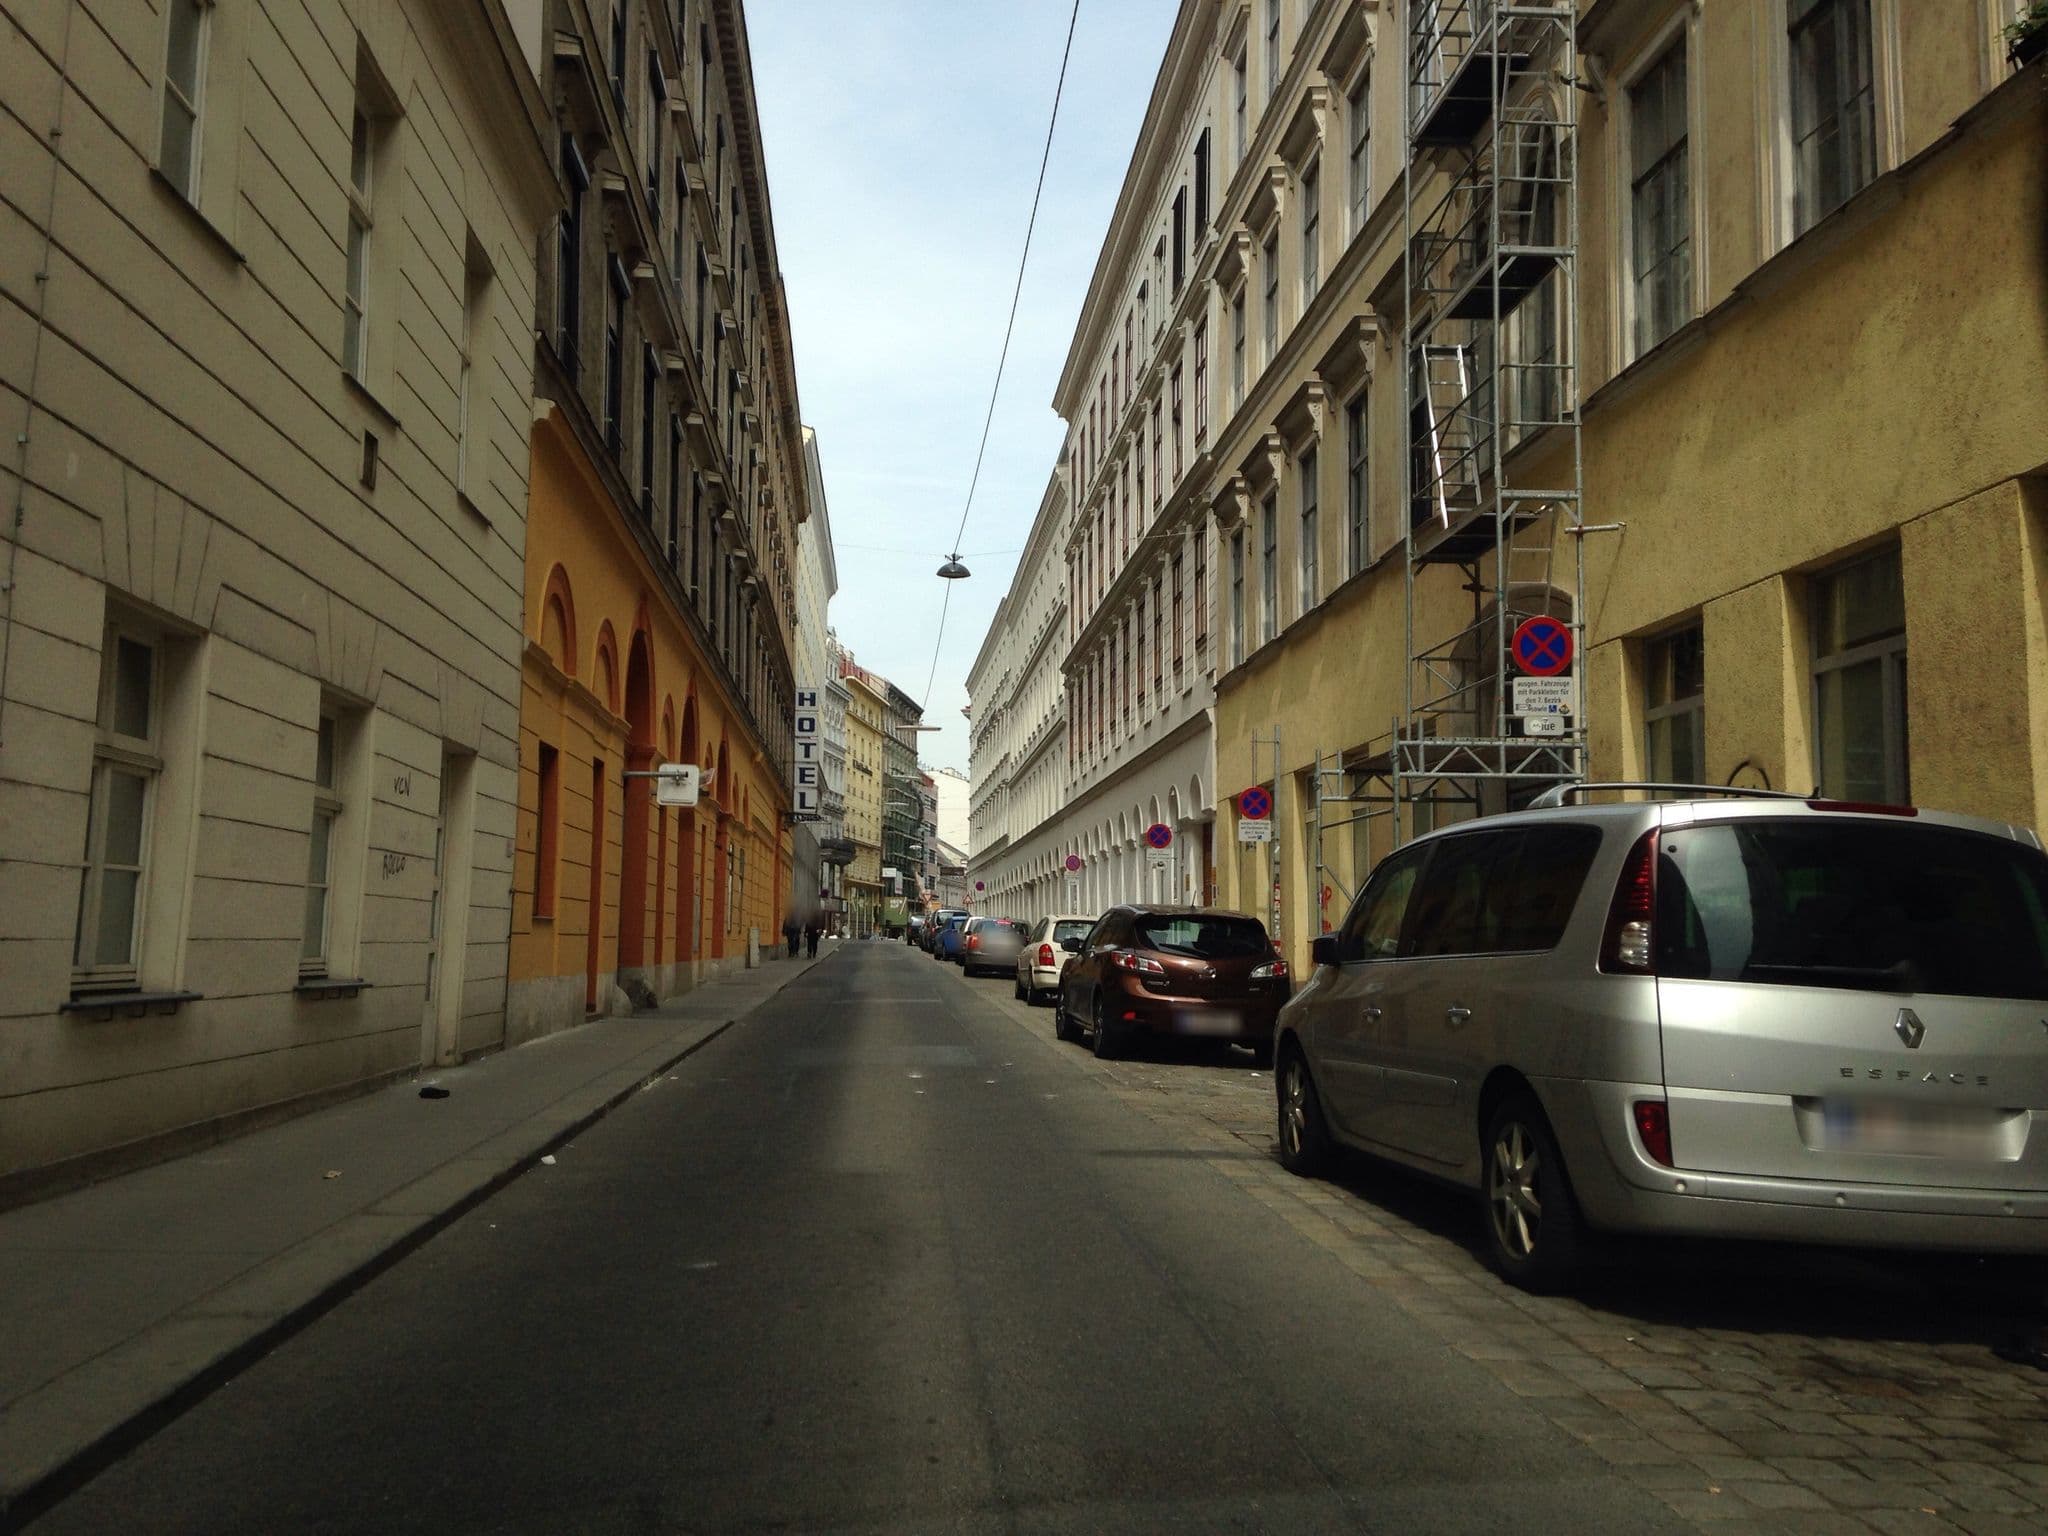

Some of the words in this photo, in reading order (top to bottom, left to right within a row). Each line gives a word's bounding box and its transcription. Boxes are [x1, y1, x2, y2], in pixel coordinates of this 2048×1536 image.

[1540, 680, 1570, 688] Fahrzeuge
[797, 692, 817, 810] HOTEL
[1840, 1067, 1988, 1086] ESPACE
